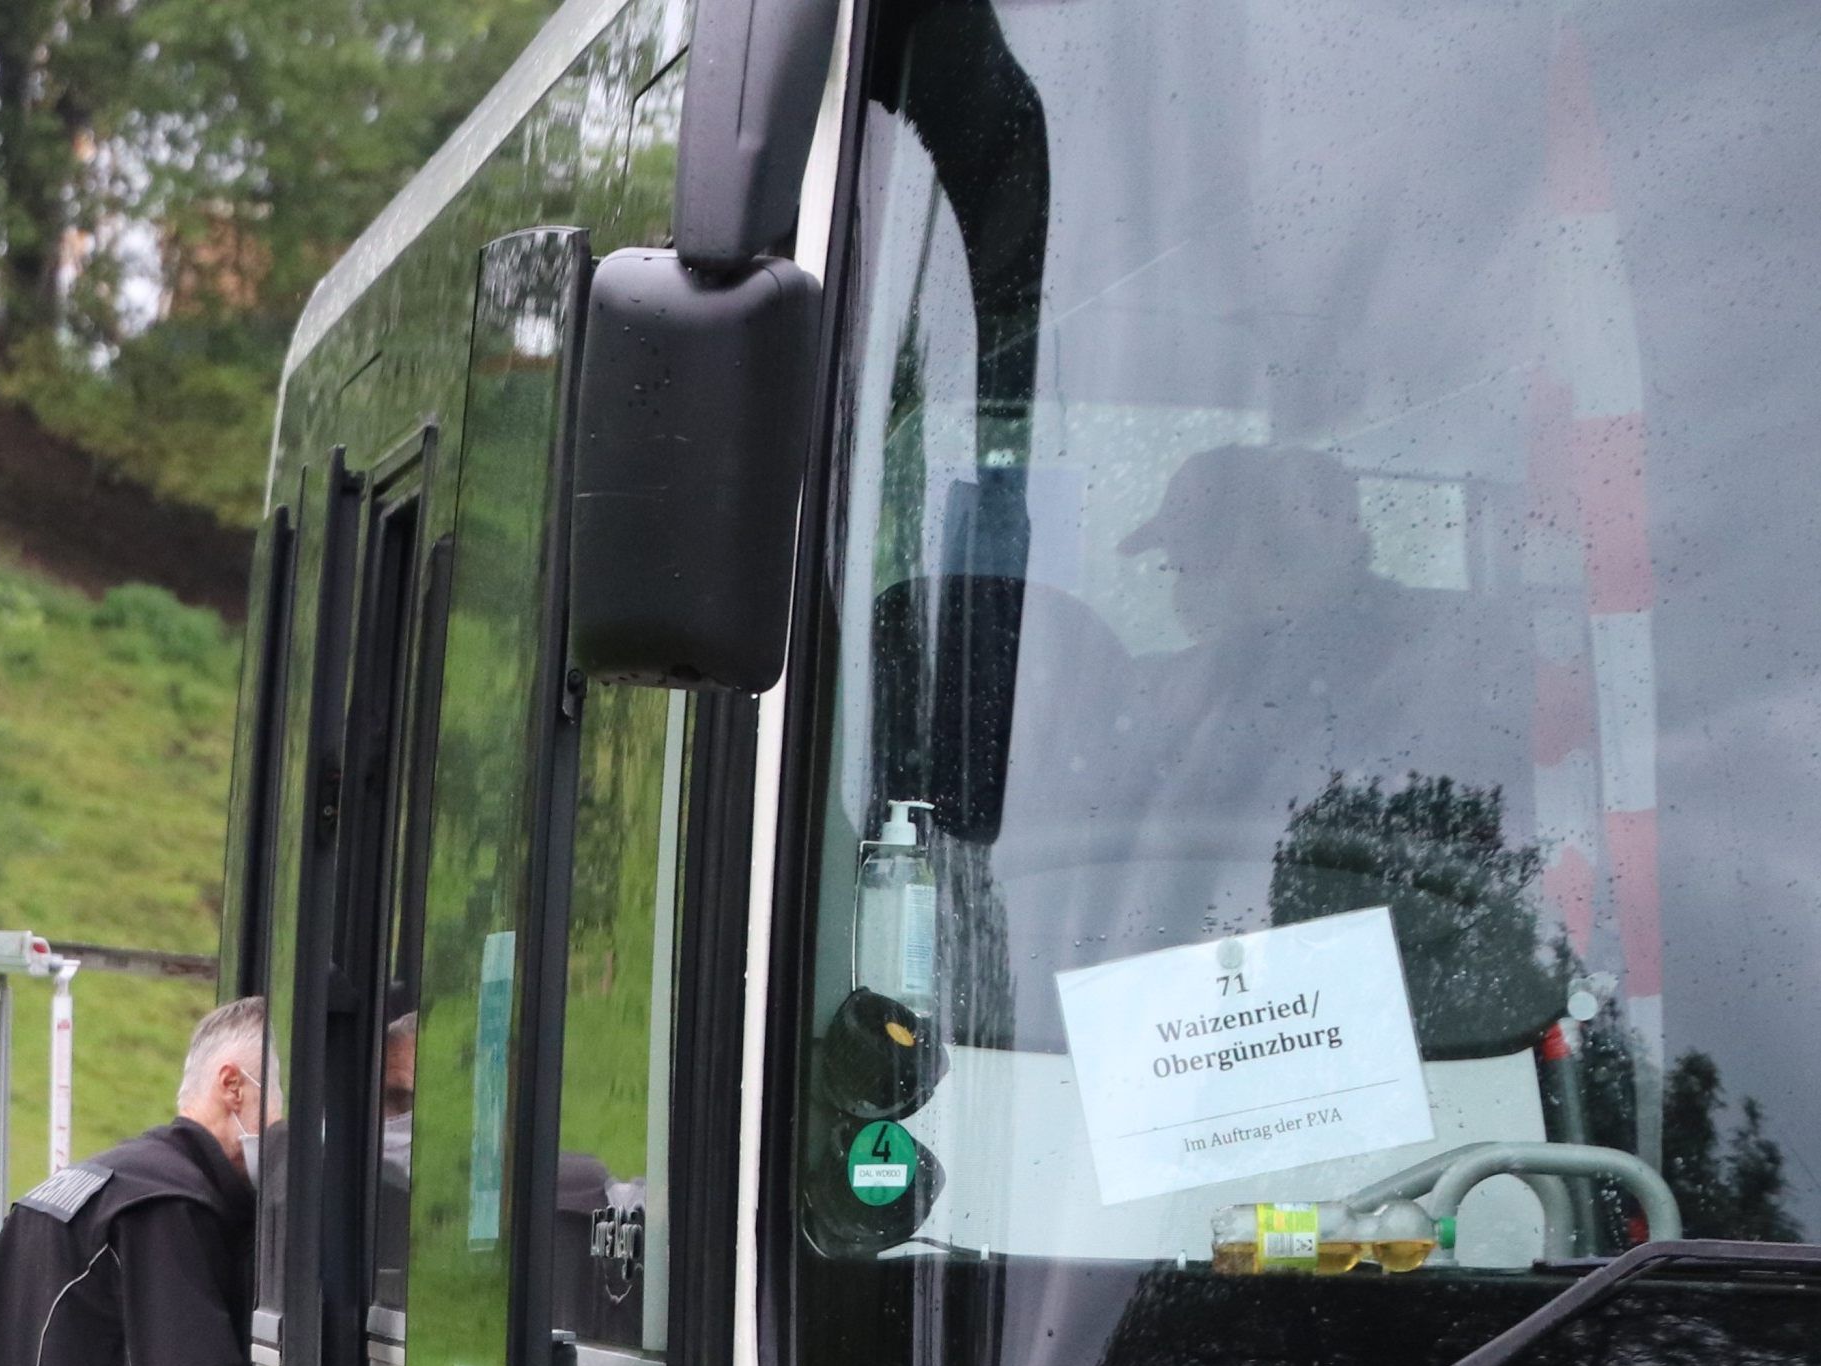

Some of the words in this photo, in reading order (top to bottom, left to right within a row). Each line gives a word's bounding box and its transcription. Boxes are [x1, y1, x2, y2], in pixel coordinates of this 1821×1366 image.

[1215, 971, 1250, 998] 71
[1155, 989, 1322, 1045] Waizenried/
[1152, 1022, 1344, 1080] Obergünzburg
[871, 1123, 892, 1163] 4
[1184, 1135, 1208, 1154] Im
[1210, 1117, 1273, 1149] Auftrag
[1274, 1116, 1303, 1134] der
